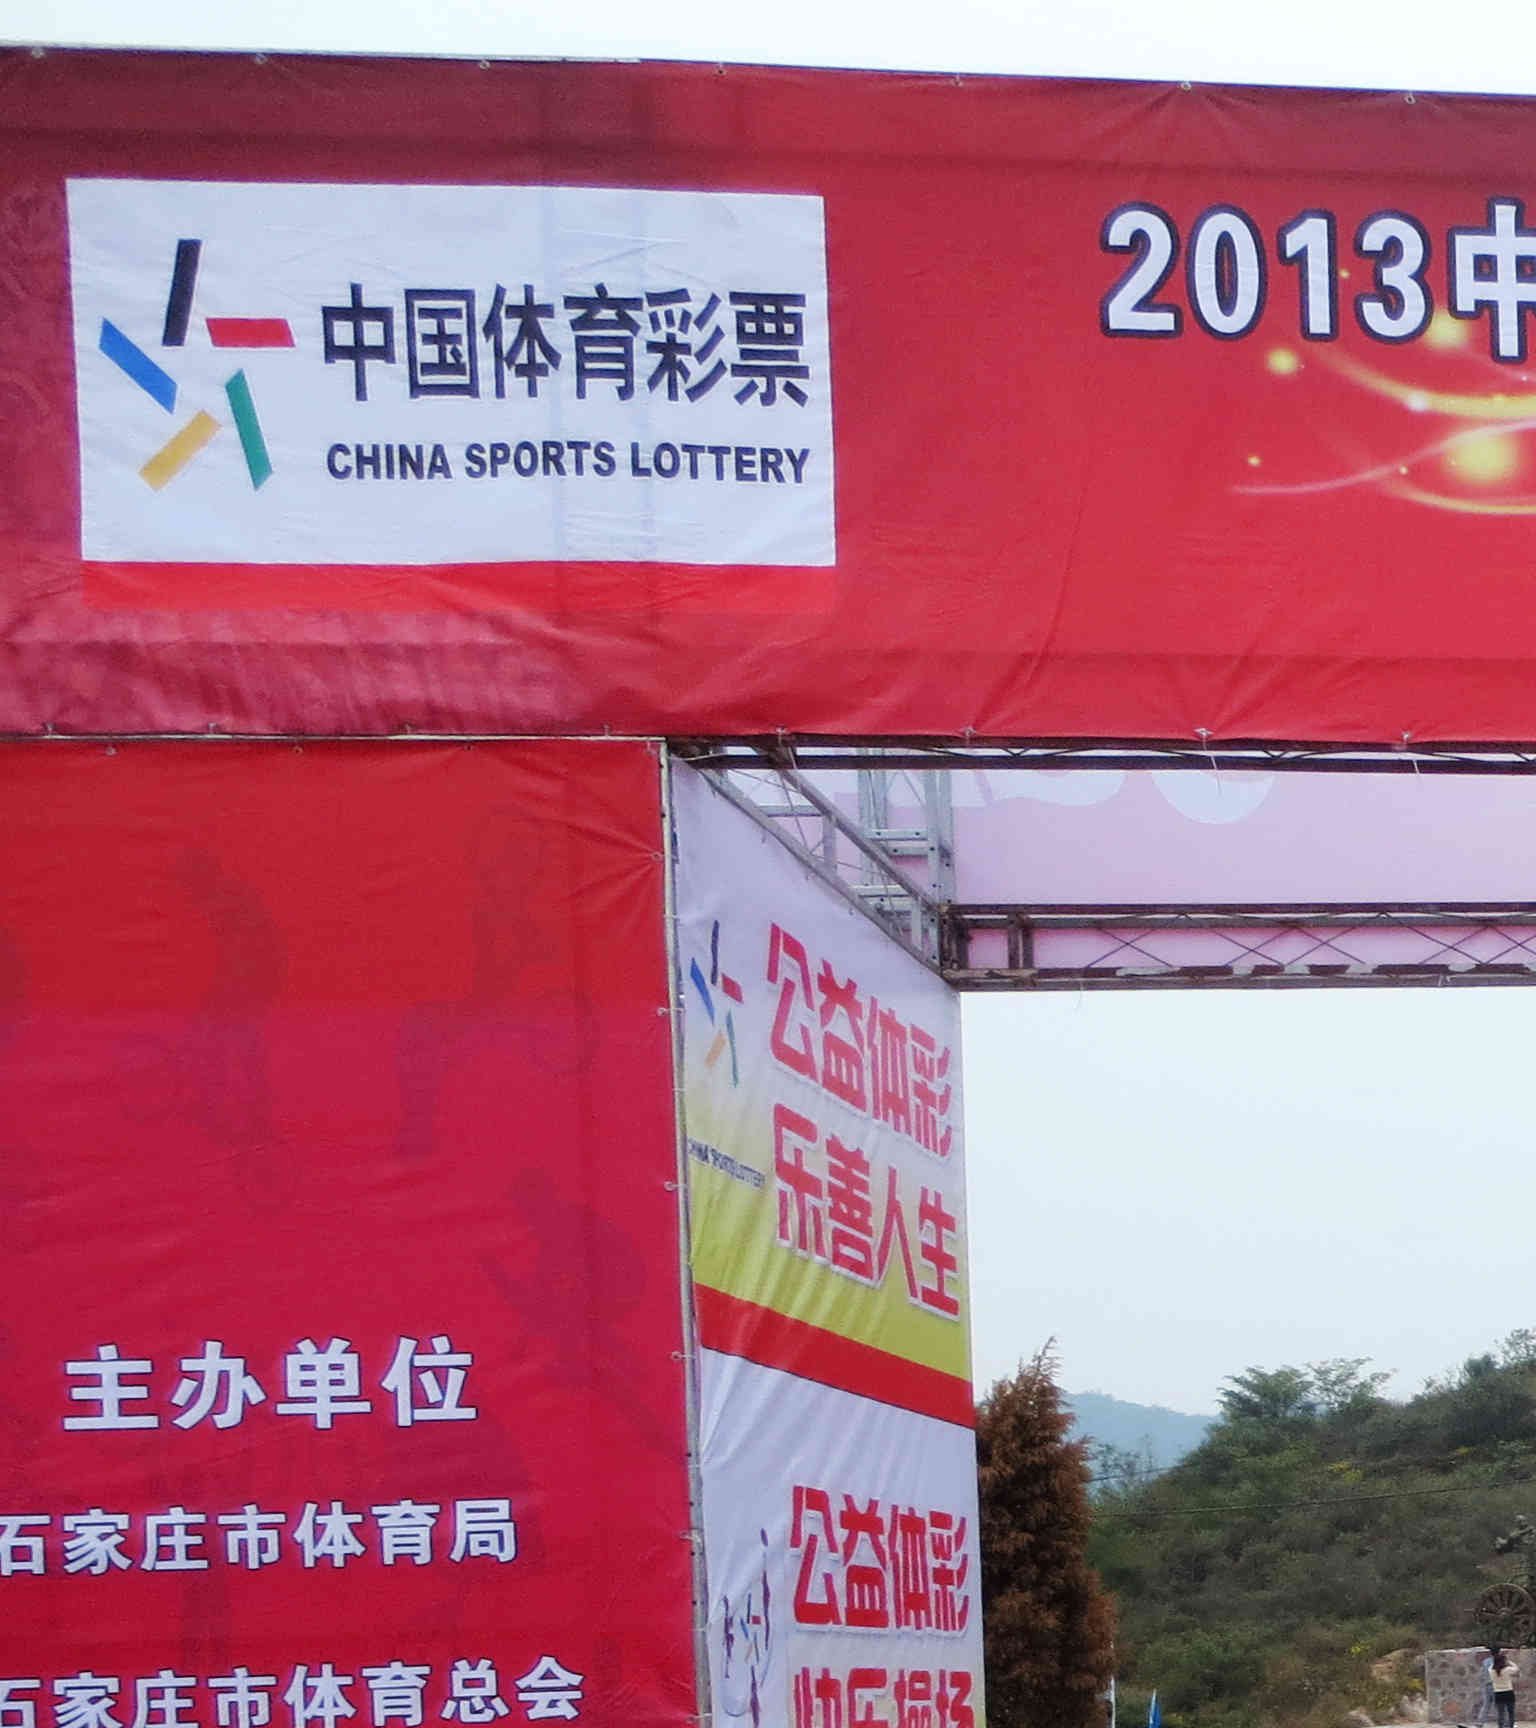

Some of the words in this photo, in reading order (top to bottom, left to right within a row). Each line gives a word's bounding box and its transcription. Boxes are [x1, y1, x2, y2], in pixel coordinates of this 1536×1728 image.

[321, 282, 810, 408] 中国体育彩票
[328, 442, 452, 482] CHINA
[465, 440, 617, 480] SPORTS
[630, 441, 811, 485] LOTTERY
[767, 921, 952, 1159] 公益体彩
[773, 1102, 960, 1318] 乐善人生
[62, 1335, 478, 1432] 主办单位
[0, 1498, 517, 1576] 石家庄市体育局
[793, 1484, 968, 1632] 公益体彩
